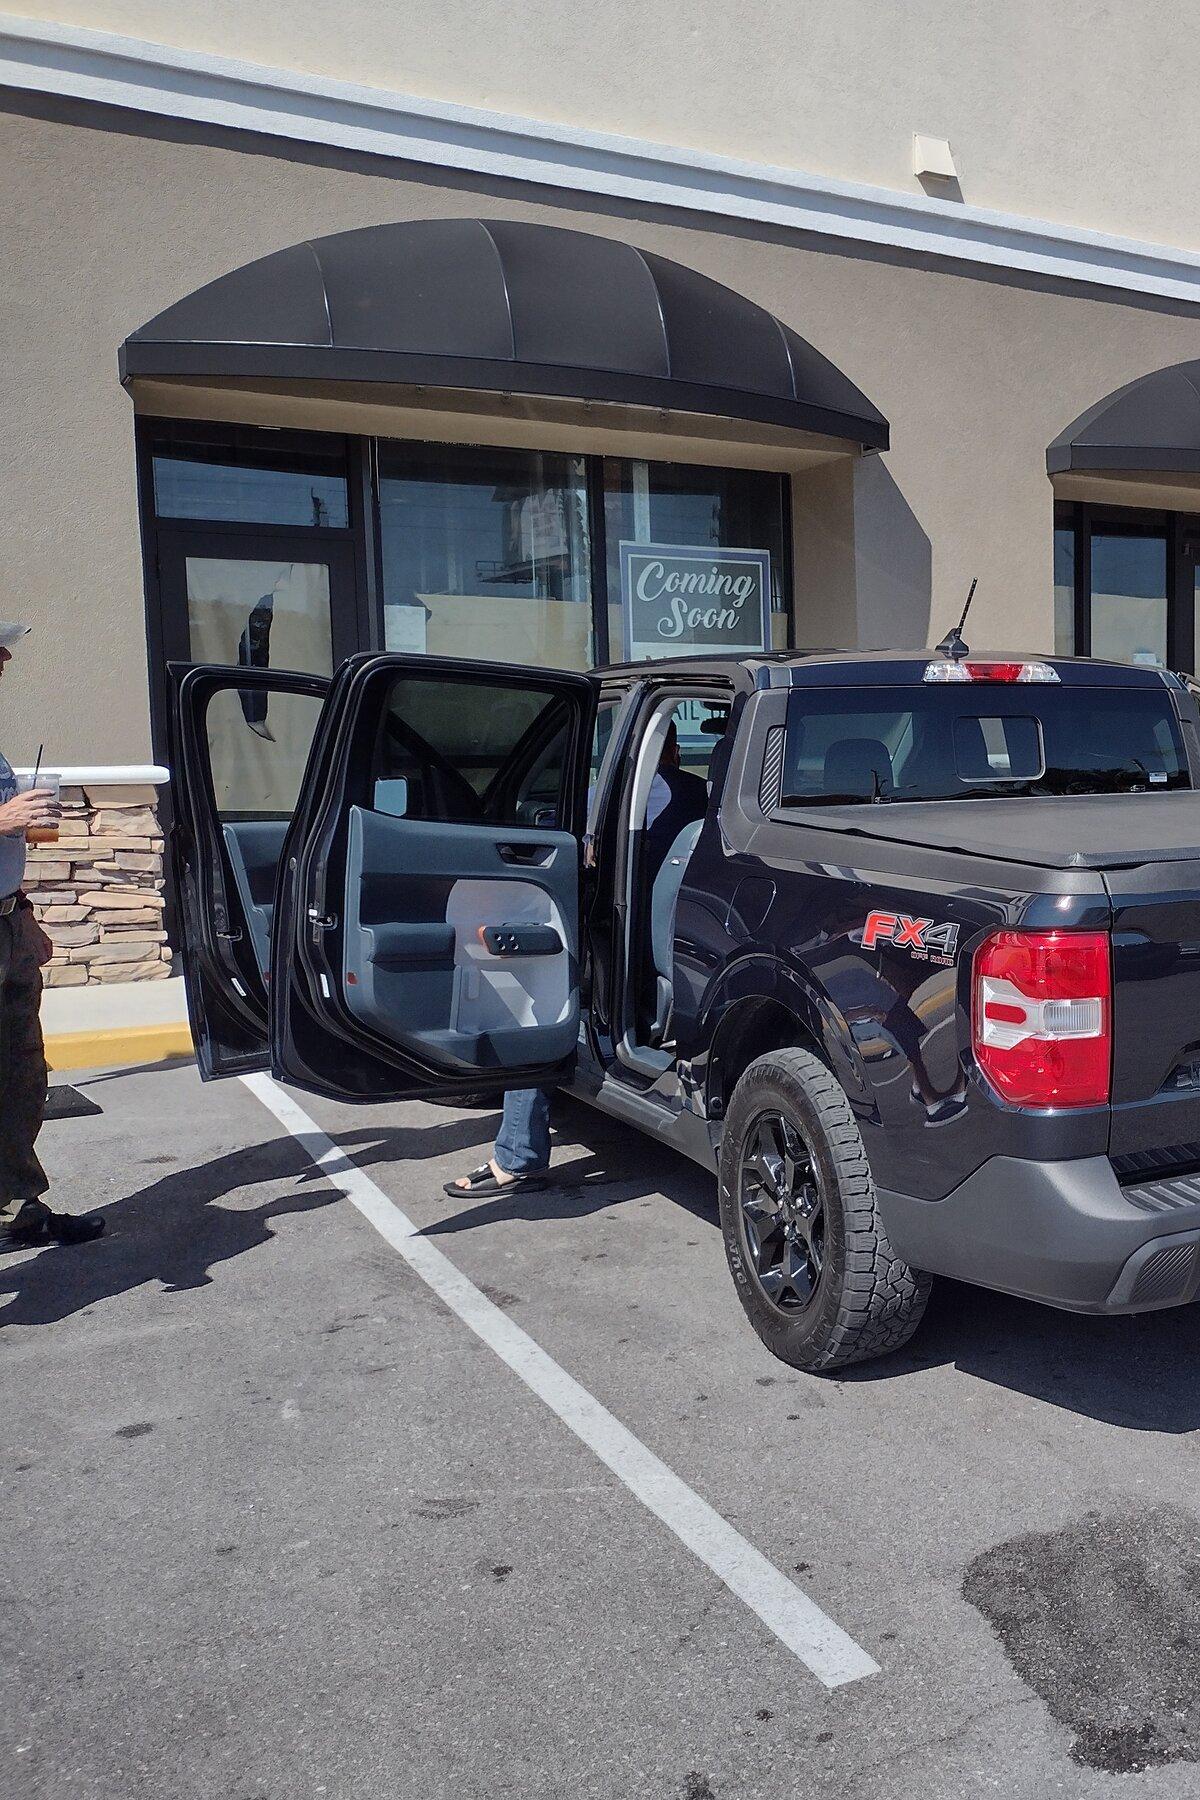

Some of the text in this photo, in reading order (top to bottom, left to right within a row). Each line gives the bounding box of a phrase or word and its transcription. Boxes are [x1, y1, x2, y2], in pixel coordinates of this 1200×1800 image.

[636, 561, 756, 608] Coming
[657, 597, 740, 637] Soon
[860, 909, 960, 958] FX4
